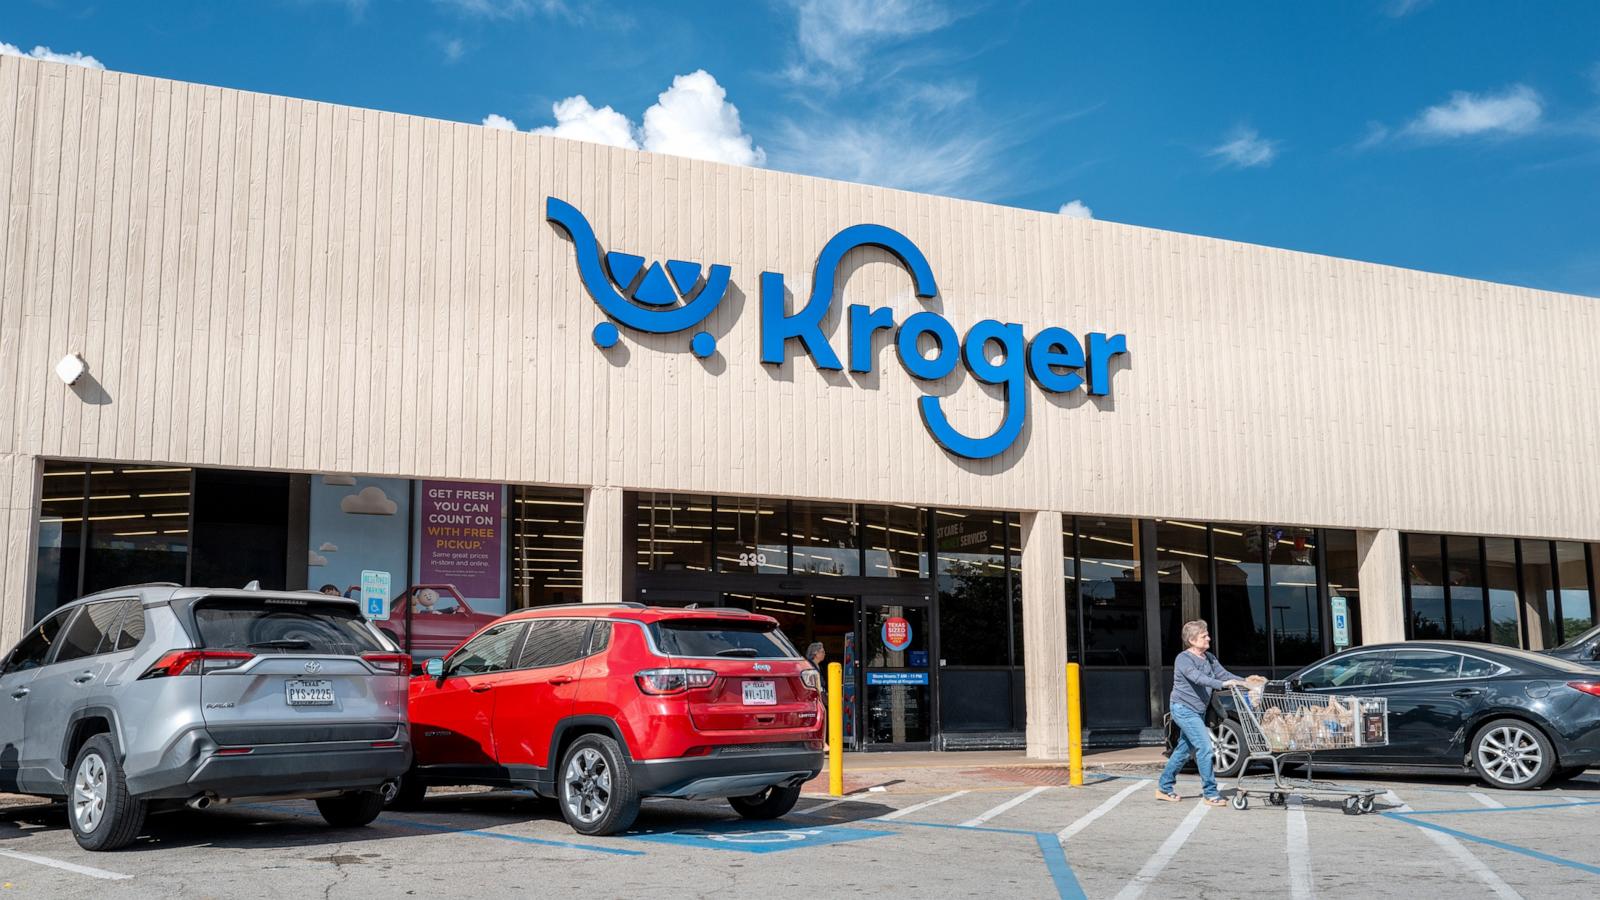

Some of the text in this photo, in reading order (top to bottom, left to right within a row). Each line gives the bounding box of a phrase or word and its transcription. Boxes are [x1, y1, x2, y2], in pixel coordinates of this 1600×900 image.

[759, 223, 1126, 459] Kroger
[428, 489, 495, 500] GET FRESH
[433, 501, 489, 512] YOU CAN
[428, 514, 494, 525] COUNT ON
[427, 527, 495, 538] WITH FREE
[961, 531, 987, 546] SERVICES
[470, 552, 489, 560] prices
[739, 552, 767, 567] 239
[753, 662, 771, 672] Jeep
